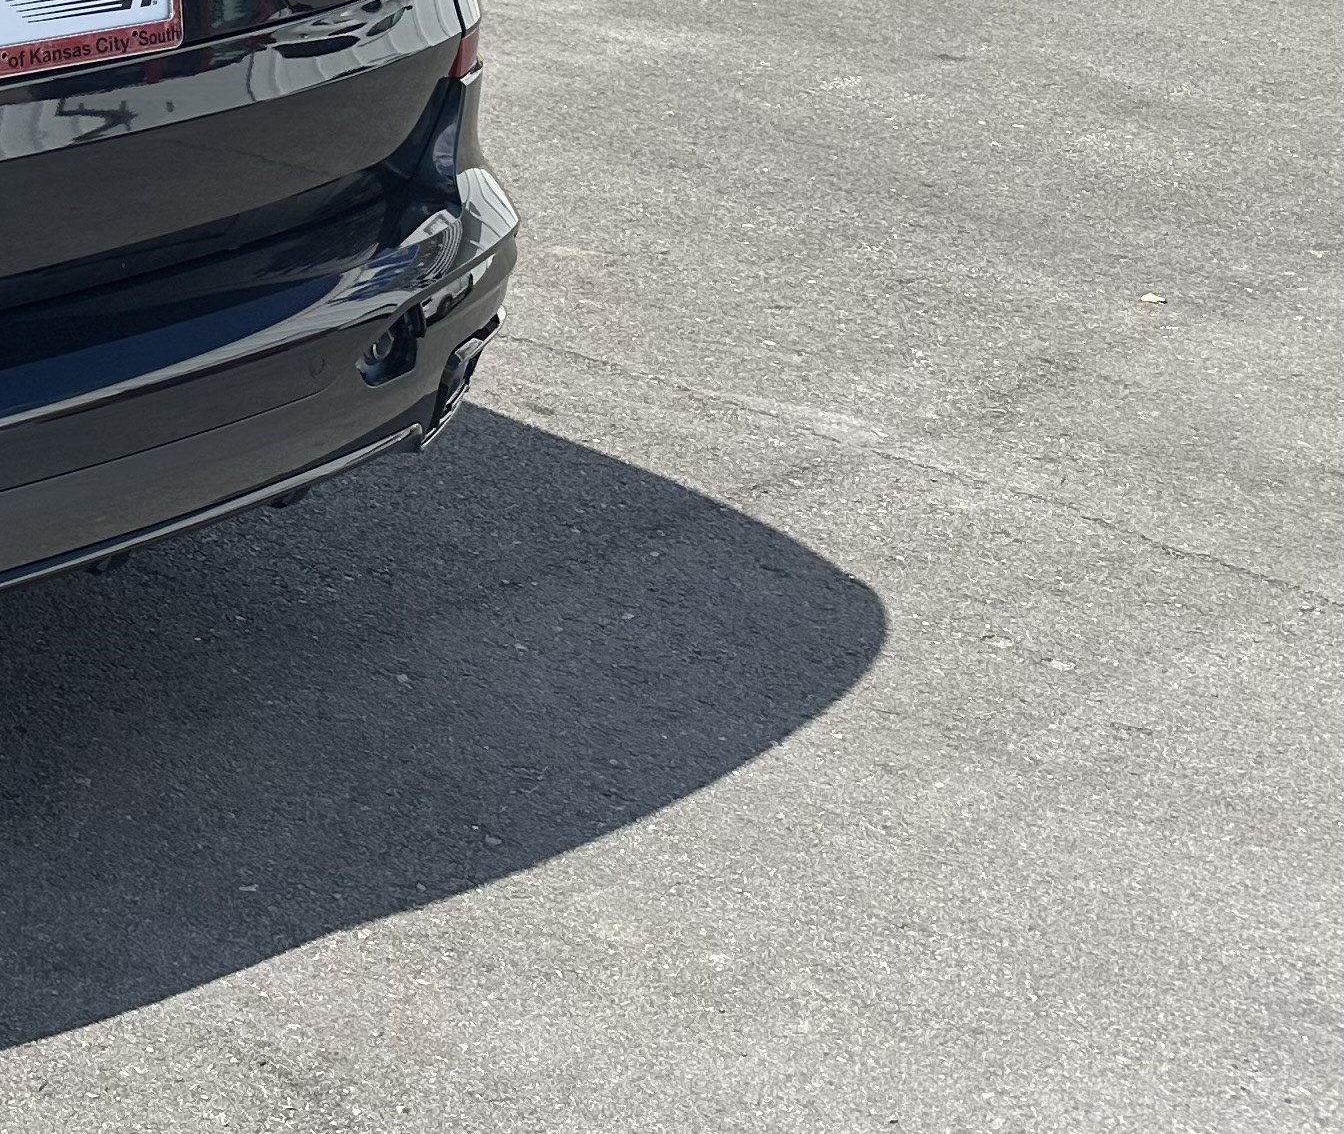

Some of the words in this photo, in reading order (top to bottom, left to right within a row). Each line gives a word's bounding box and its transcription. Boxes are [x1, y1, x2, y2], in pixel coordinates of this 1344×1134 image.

[8, 50, 26, 69] of
[30, 43, 92, 65] Kansas
[96, 36, 130, 54] City
[138, 25, 182, 46] South
